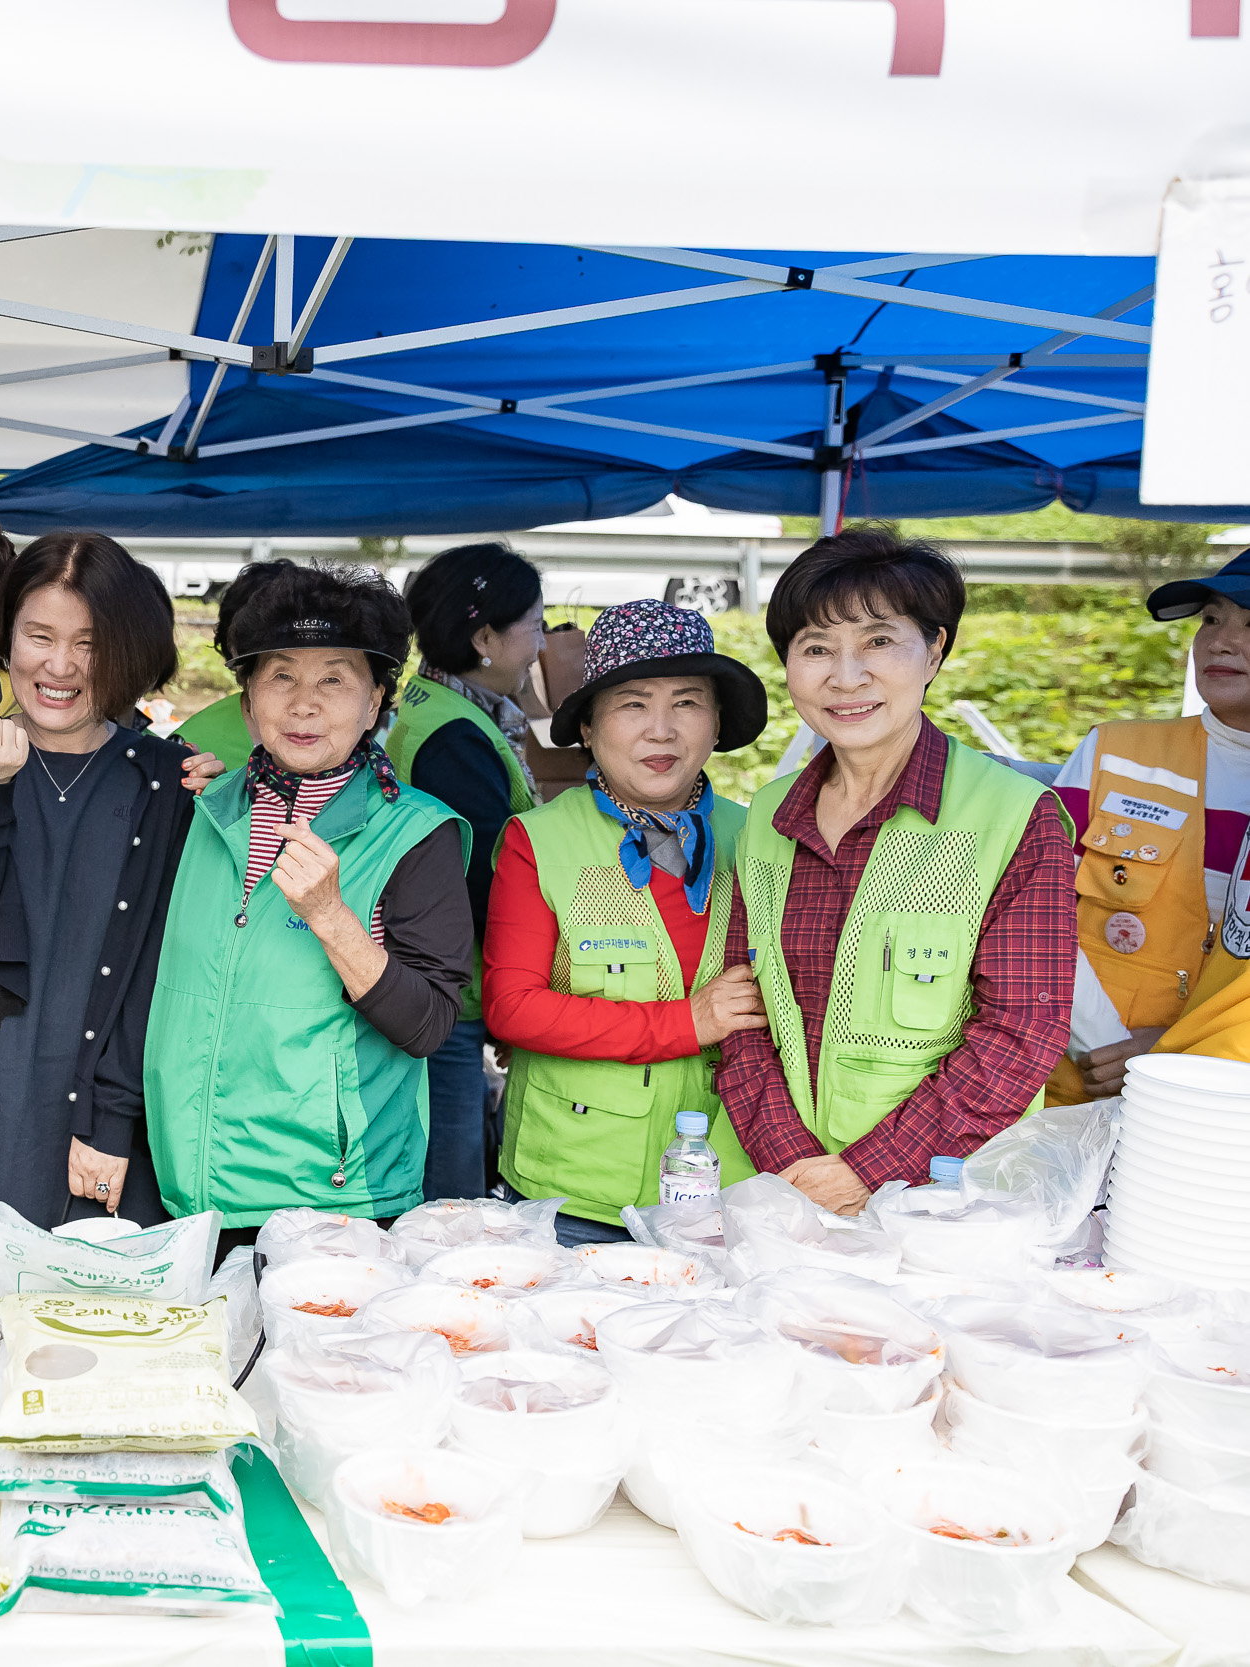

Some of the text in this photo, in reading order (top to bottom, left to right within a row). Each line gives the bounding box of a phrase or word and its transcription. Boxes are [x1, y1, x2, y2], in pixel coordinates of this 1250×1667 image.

[285, 916, 312, 931] SM
[592, 938, 648, 950] 광진구자원봉사센터
[30, 1304, 210, 1327] 곤드레나물 전병
